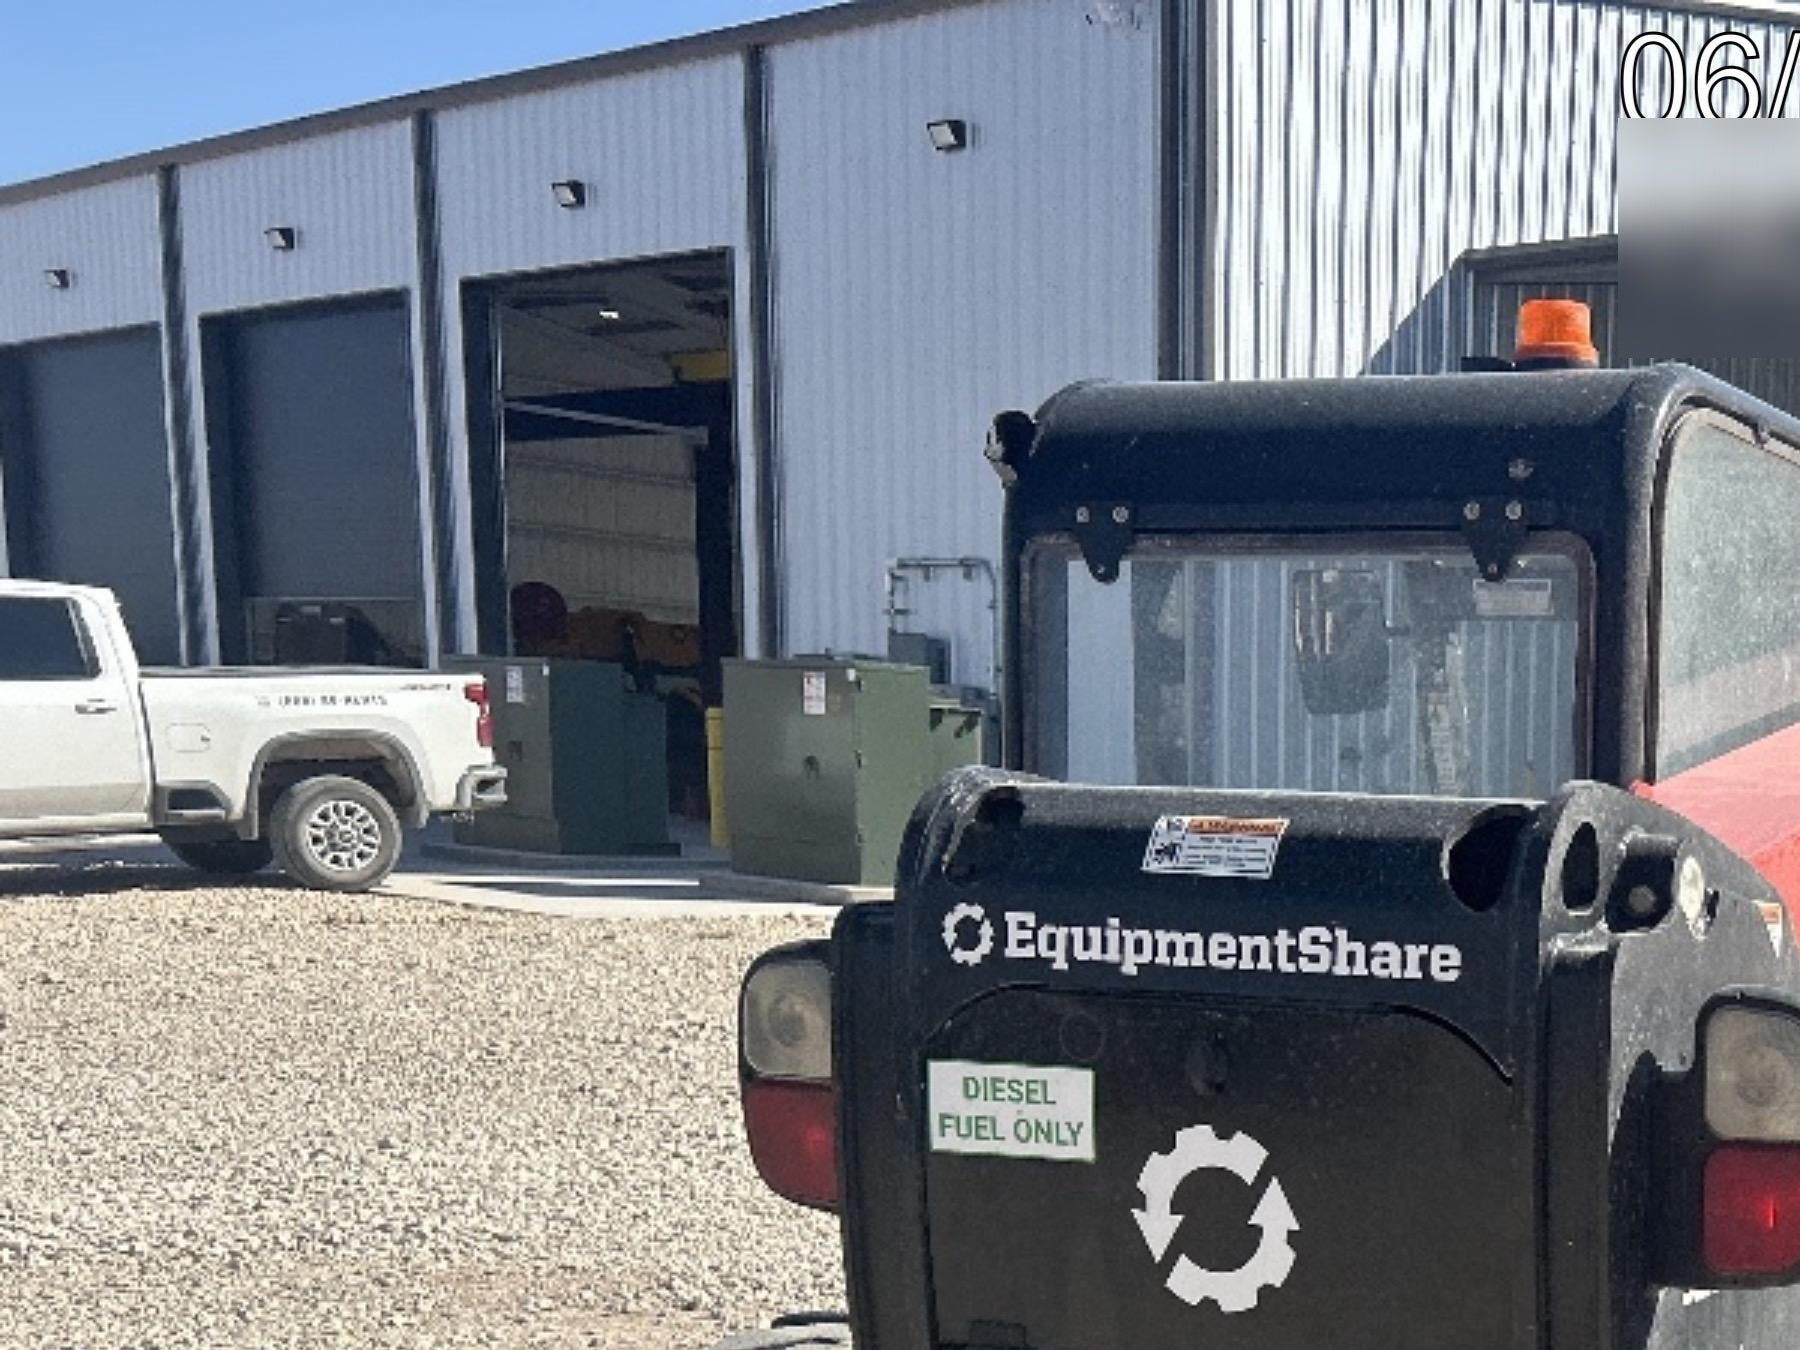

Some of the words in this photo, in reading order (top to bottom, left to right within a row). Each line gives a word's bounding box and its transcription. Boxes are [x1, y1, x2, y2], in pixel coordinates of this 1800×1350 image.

[1004, 911, 1463, 982] EquipmentShare
[962, 1075, 1057, 1106] DIESEL
[938, 1113, 1006, 1143] FUEL
[1015, 1118, 1084, 1148] ONLY
